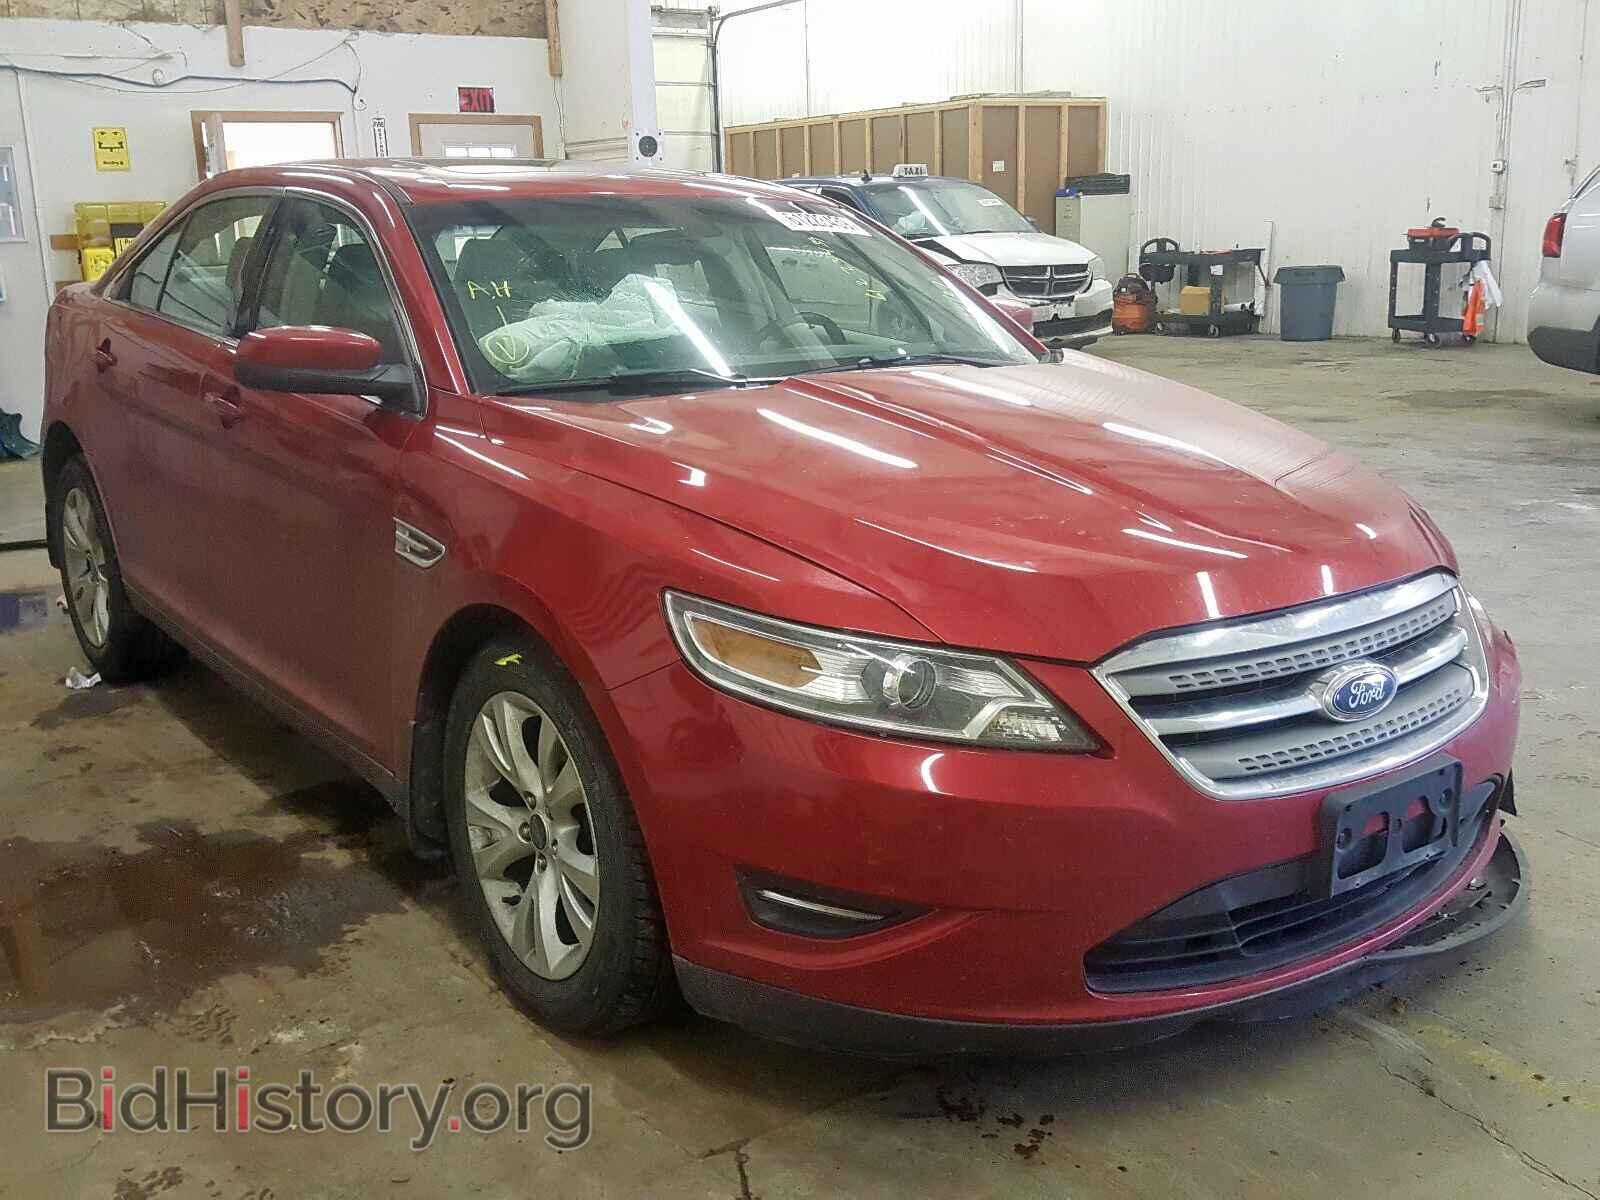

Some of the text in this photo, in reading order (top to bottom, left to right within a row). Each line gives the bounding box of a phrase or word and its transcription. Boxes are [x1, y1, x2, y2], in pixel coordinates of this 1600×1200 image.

[460, 88, 493, 112] EXIT
[903, 167, 923, 176] TAXI
[1348, 679, 1386, 709] Ford
